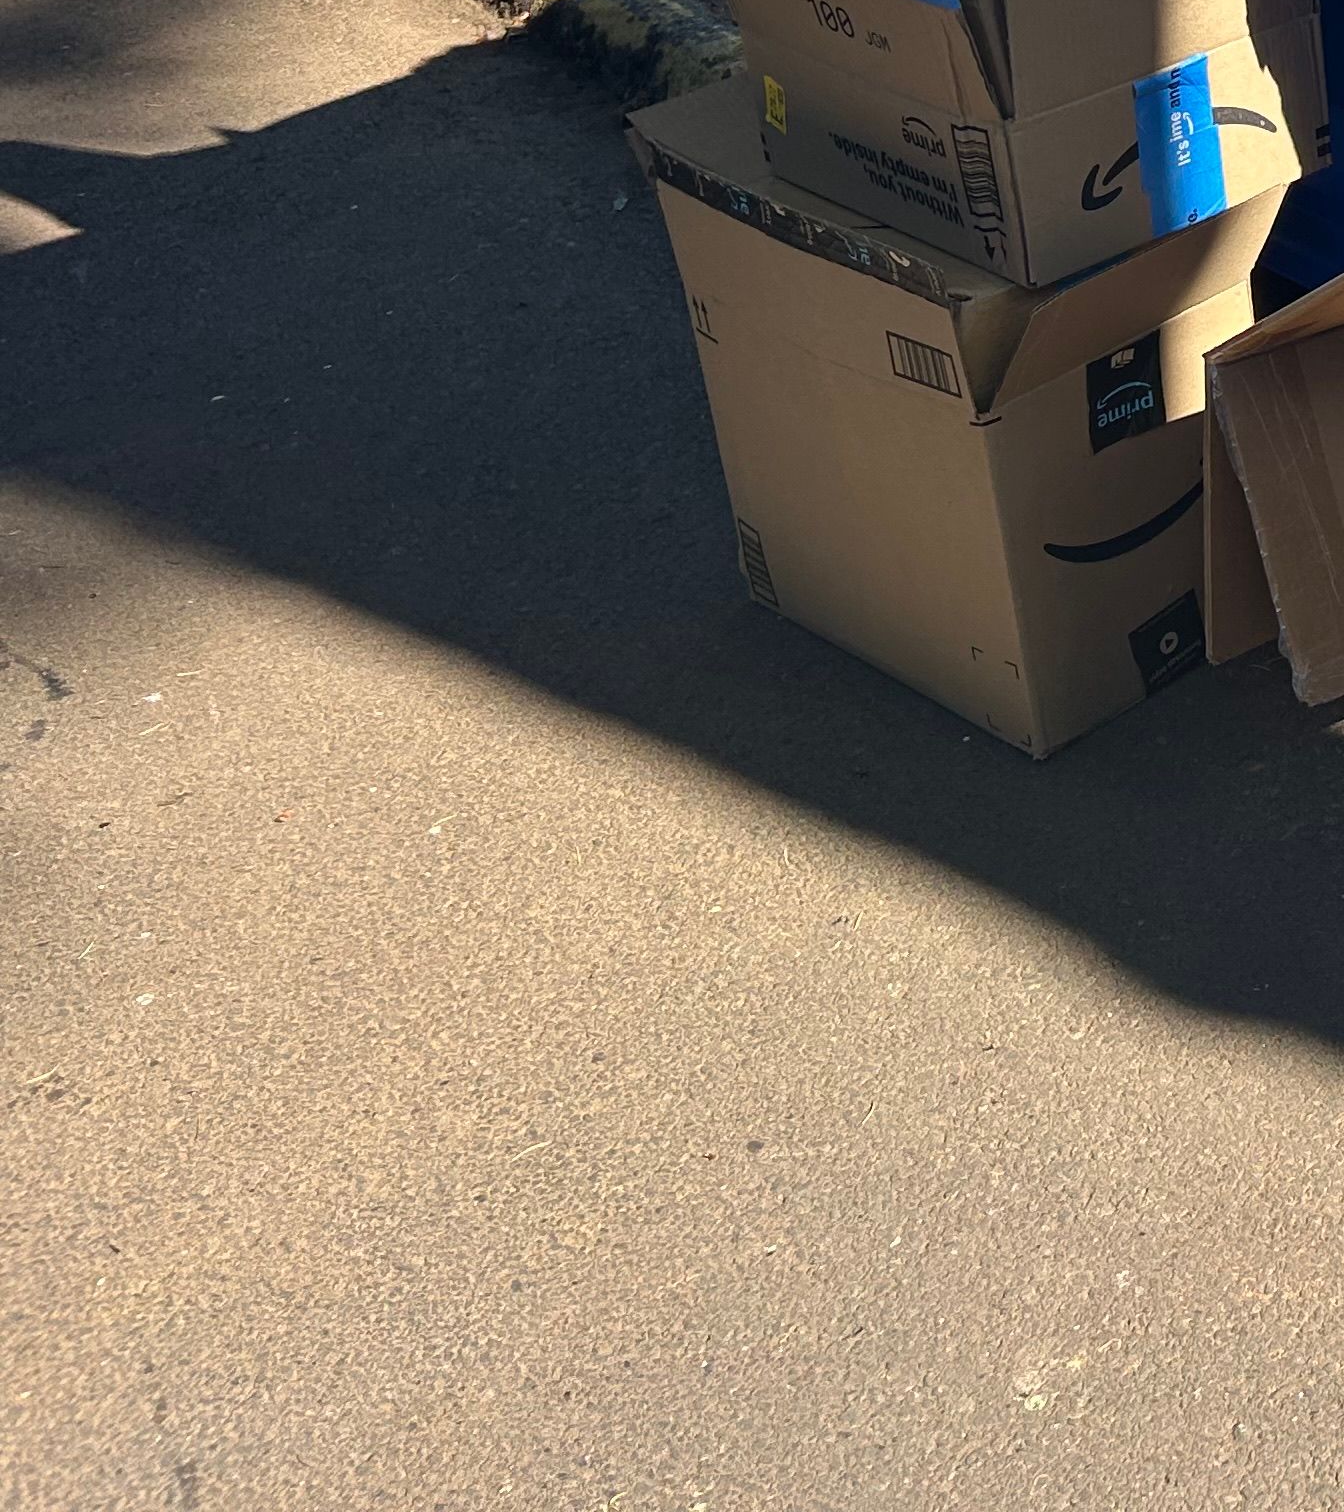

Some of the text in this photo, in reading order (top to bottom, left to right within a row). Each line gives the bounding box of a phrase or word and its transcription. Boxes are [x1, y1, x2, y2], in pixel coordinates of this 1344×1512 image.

[1169, 79, 1182, 109] and
[902, 127, 948, 159] prime
[1177, 140, 1193, 168] It's
[828, 132, 960, 203] I'm empty inside.
[901, 180, 965, 228] Without
[1096, 391, 1155, 429] prime
